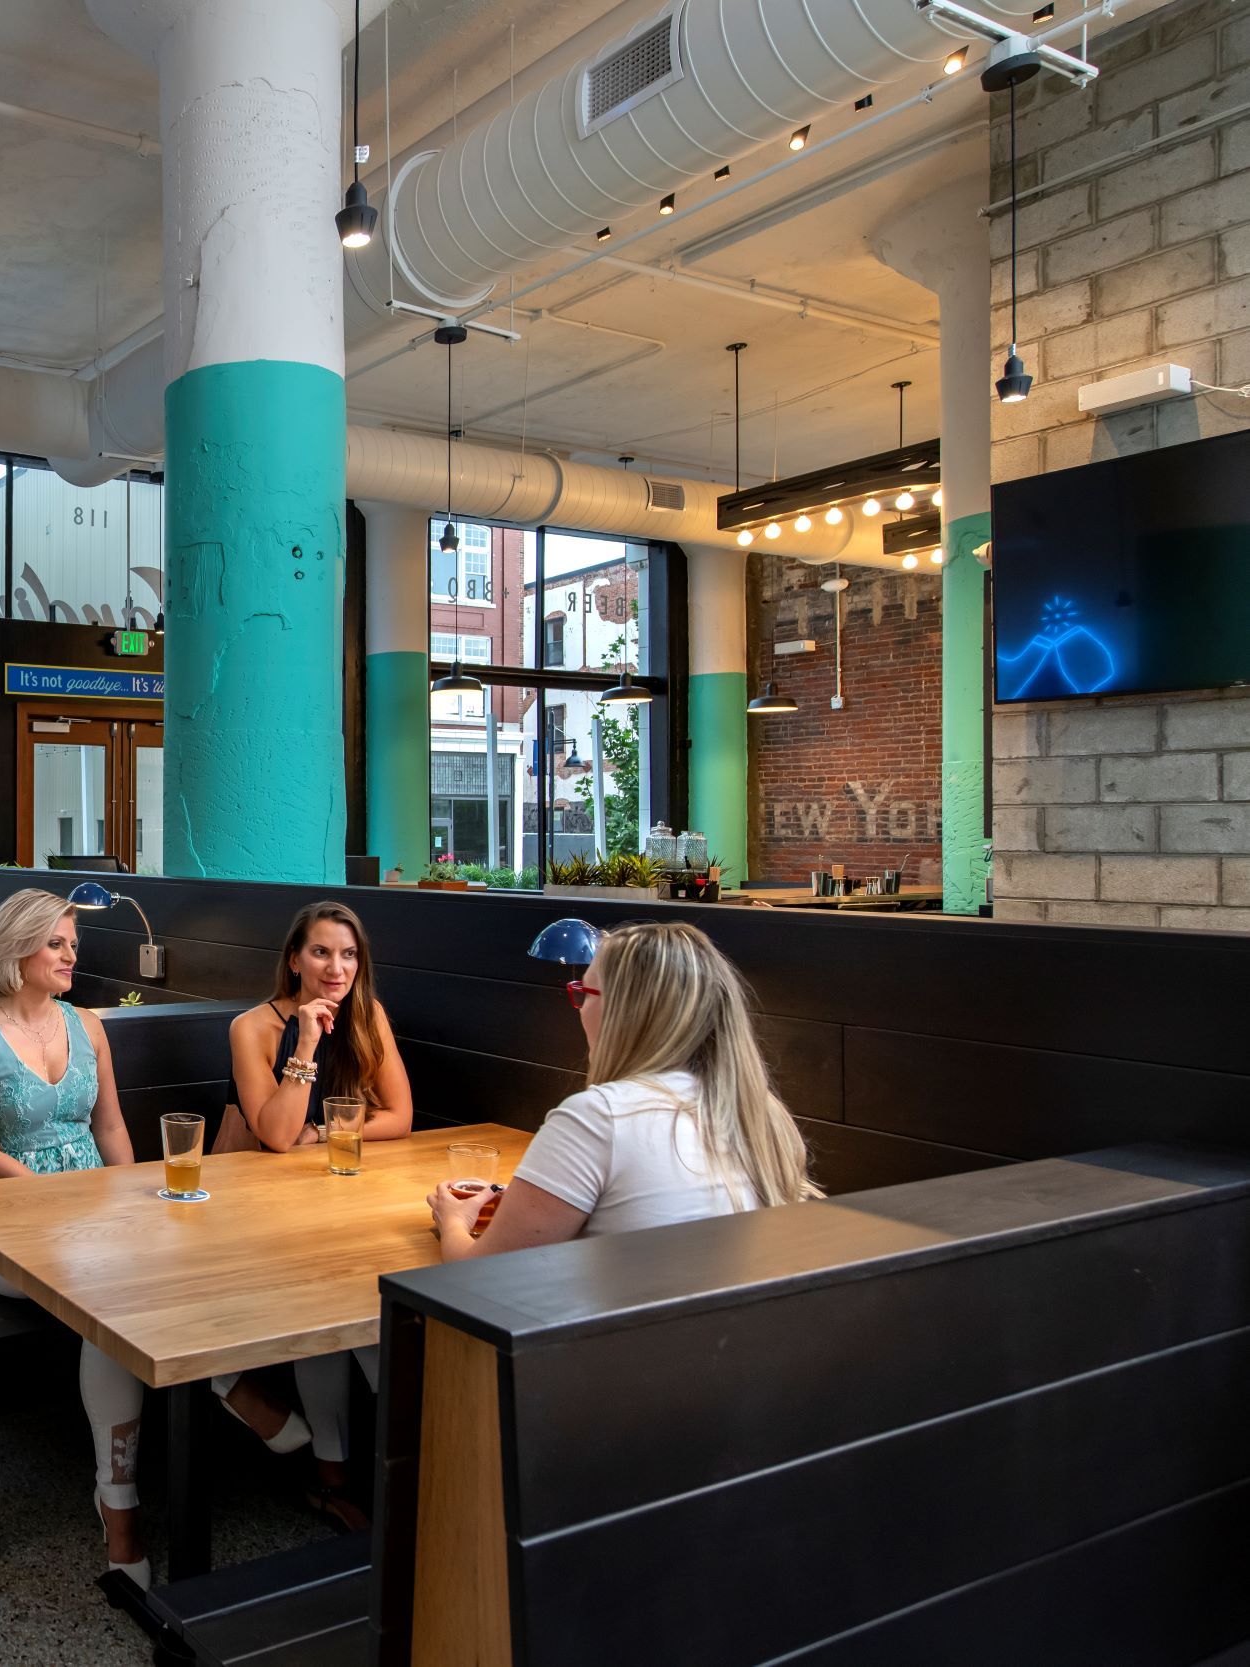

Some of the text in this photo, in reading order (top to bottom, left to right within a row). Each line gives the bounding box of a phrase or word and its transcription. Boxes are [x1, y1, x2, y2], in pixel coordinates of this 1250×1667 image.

[73, 507, 108, 528] 811
[121, 632, 146, 654] EXIT
[20, 670, 38, 688] It's
[41, 674, 63, 688] not
[66, 676, 129, 695] goodbye...
[132, 677, 149, 693] It's
